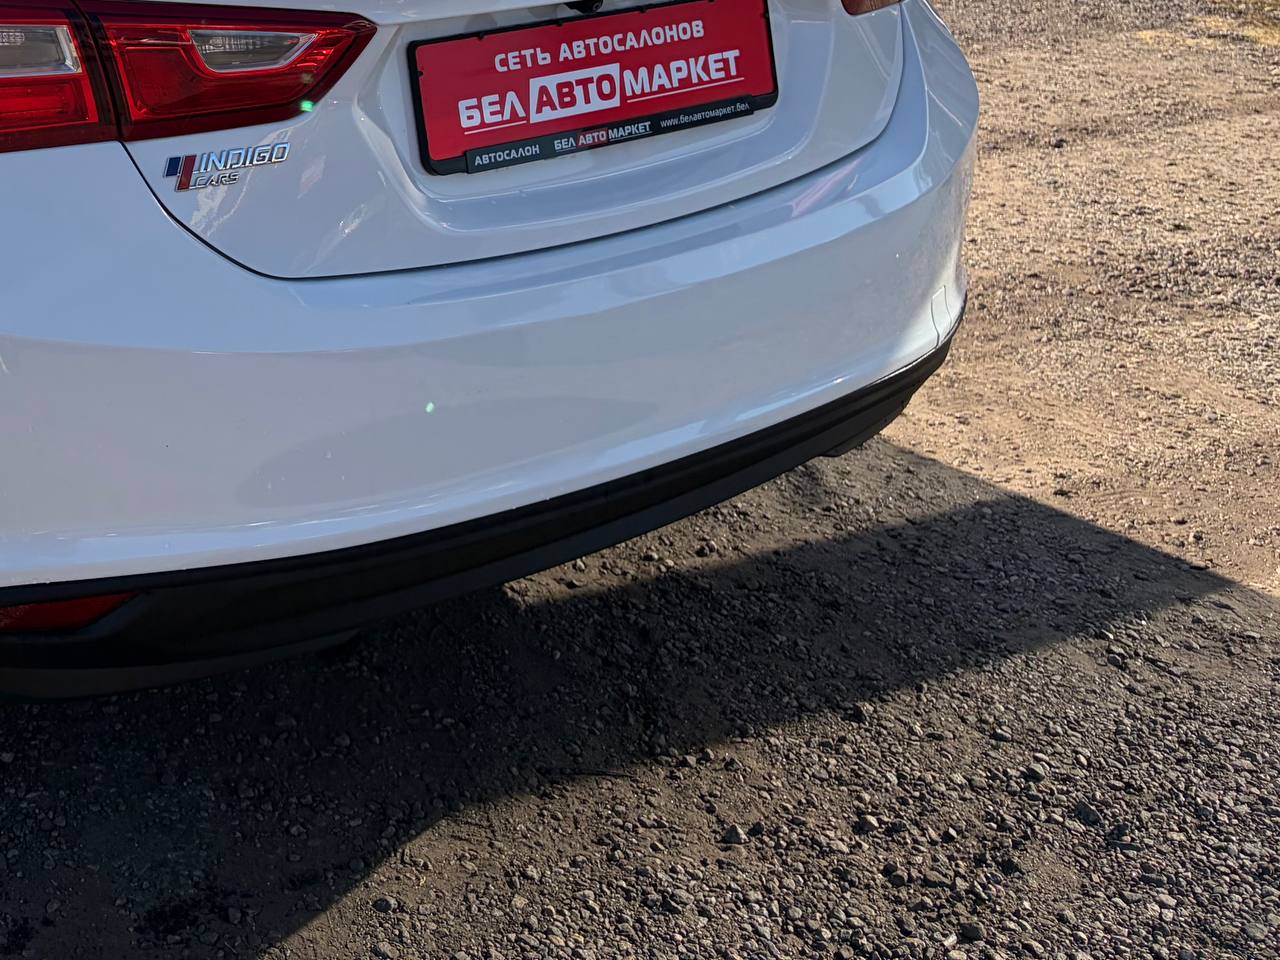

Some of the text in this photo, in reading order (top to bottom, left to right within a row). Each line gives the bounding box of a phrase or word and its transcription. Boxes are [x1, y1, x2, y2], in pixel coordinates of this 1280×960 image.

[494, 20, 704, 72] СЕТЬ АВТОСАЛОНОВ
[458, 49, 740, 128] БЕЛ АВТО МАРКЕТ
[197, 142, 291, 173] INDIGO
[474, 102, 750, 166] АВТОСАЛОН БЕЛ АВТО МАРКЕТ www.белавтомаркет.бел
[194, 171, 240, 188] CARS
